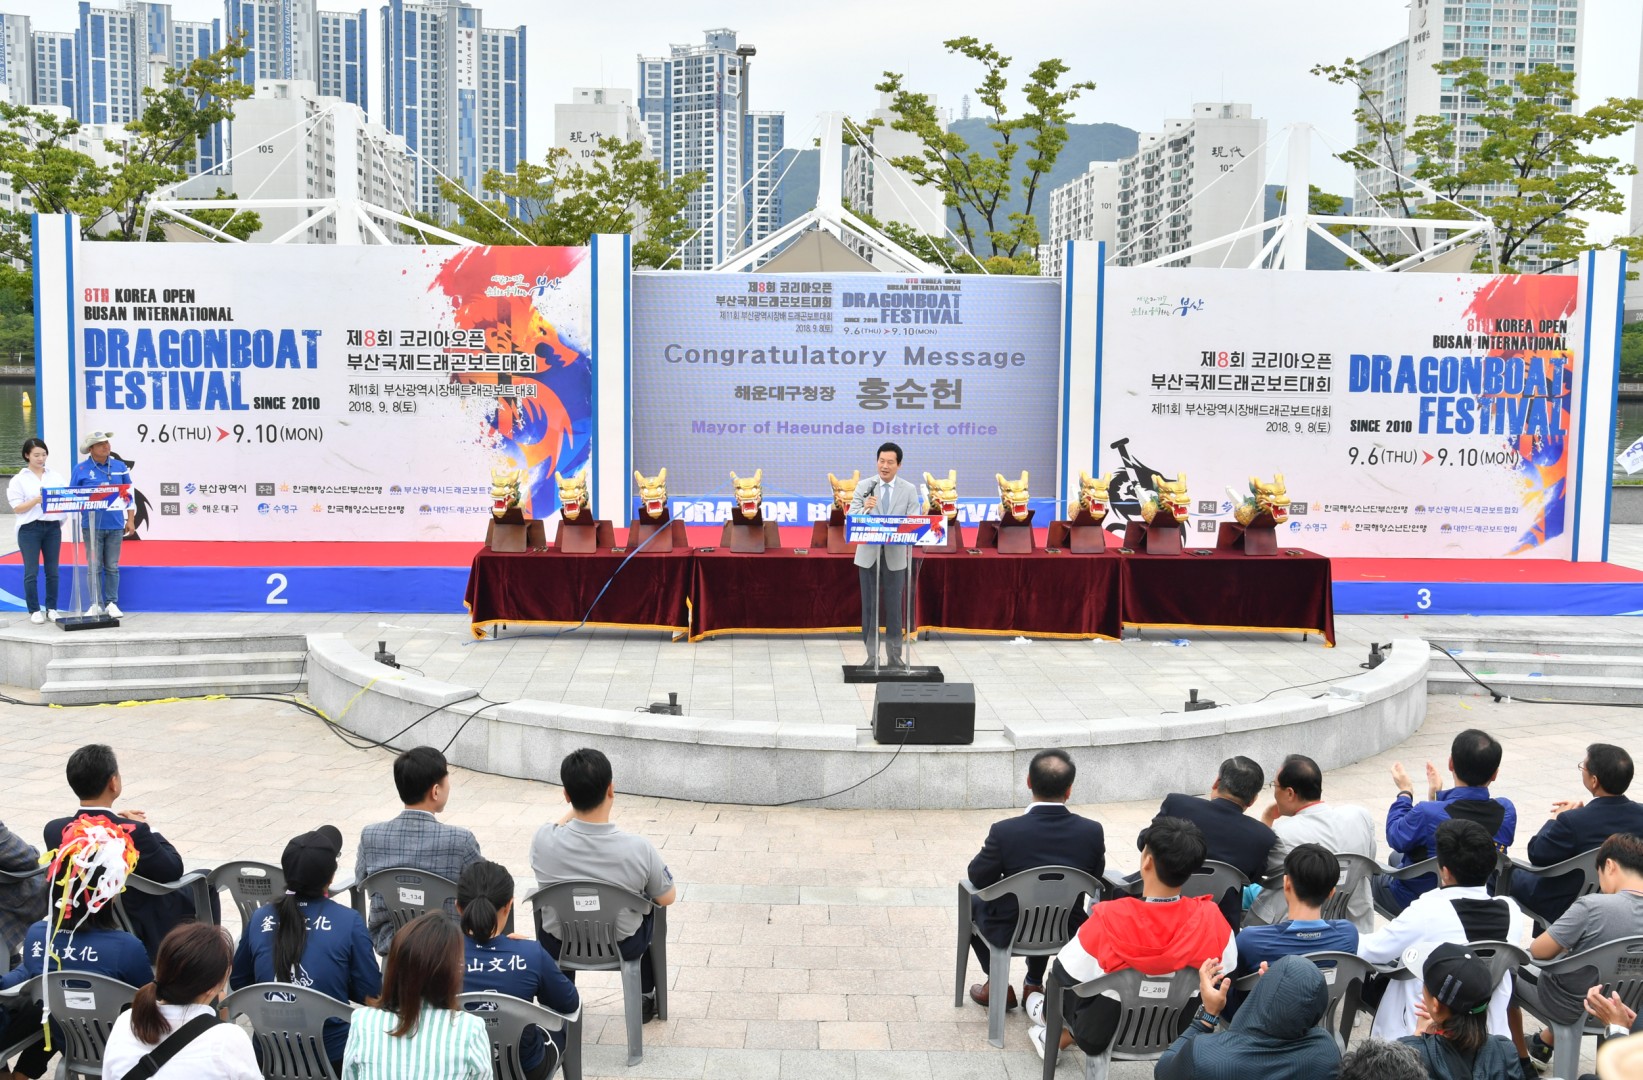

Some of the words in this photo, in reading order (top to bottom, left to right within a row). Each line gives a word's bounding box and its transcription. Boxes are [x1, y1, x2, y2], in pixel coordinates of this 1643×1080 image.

[257, 144, 274, 154] 105
[1211, 146, 1245, 158] 現代
[1101, 202, 1112, 210] 101
[748, 282, 776, 294] 제8회
[780, 282, 833, 294] 코리아오픈
[84, 288, 110, 303] 8TH
[115, 288, 157, 303] KOREA
[162, 288, 196, 304] OPEN
[715, 296, 832, 308] 부산국제드래곤보트대회
[843, 292, 963, 309] DRAGONBOAT
[1172, 296, 1205, 317] 부산
[84, 306, 128, 321] BUSAN
[133, 306, 234, 322] INTERNATIONAL
[719, 311, 740, 321] 제11회
[740, 311, 786, 322] 부산광역시장배
[787, 311, 833, 322] 드래곤보트대회
[881, 308, 964, 325] FESTIVAL
[843, 327, 882, 336] 9.6(THU)
[891, 327, 938, 337] 9.10(MON)
[1495, 319, 1533, 333] KOREA
[1539, 319, 1568, 334] OPEN
[346, 329, 393, 347] 제8회
[400, 329, 485, 349] 코리아오픈
[1433, 335, 1472, 349] BUSAN
[1477, 335, 1568, 351] INTERNATIONAL
[84, 328, 323, 370] DRAGONBOAT
[347, 353, 537, 372] 부산국제드래곤보트대회
[664, 343, 888, 368] Congratulatory
[904, 346, 1027, 370] Message
[1200, 351, 1245, 369] 제8회
[1251, 352, 1332, 370] 코리아오픈
[1348, 354, 1569, 396] DRAGONBOAT
[1151, 373, 1331, 393] 부산국제드래곤보트대회
[85, 370, 250, 411] FESTIVAL
[348, 383, 379, 397] 제11회
[384, 383, 538, 398] 부산광역시장배드래곤보트대회
[734, 385, 836, 402] 해운대구청장
[855, 377, 963, 411] 홍순헌
[253, 397, 286, 410] SINCE
[292, 397, 321, 411] 2010
[348, 401, 375, 414] 2018.
[392, 401, 417, 414] 8(토)
[1151, 402, 1181, 416] 제11회
[1185, 403, 1331, 418] 부산광역시장배드래곤보트대회
[1418, 396, 1567, 436] FESTIVAL
[691, 421, 746, 437] Mayor
[753, 421, 771, 434] of
[776, 421, 865, 435] Haeundae
[872, 422, 940, 435] District
[947, 423, 997, 436] office
[1266, 422, 1290, 434] 2018.
[1307, 422, 1331, 434] 8(토)
[1350, 419, 1381, 433] SINCE
[1386, 420, 1413, 433] 2010
[137, 423, 212, 444] 9.6(THU)
[233, 424, 324, 444] 9.10(MON)
[1348, 446, 1418, 466] 9.6(THU)
[1437, 447, 1520, 467] 9.10(MON)
[162, 484, 178, 495] 주최
[199, 483, 247, 494] 부산광역시
[258, 484, 273, 495] 주관
[292, 484, 383, 495] 한국해양소년단부산연맹
[83, 500, 109, 510] FESTIVAL
[163, 503, 179, 514] 후원
[202, 504, 239, 514] 해운대구
[273, 504, 298, 514] 수영구
[327, 504, 405, 514] 한국해양소년단연맹
[673, 501, 798, 523] DRAON
[1200, 502, 1216, 513] 주최
[1291, 504, 1306, 514] 주관
[1324, 504, 1409, 514] 한국해양소년단부산연맹
[1427, 505, 1519, 514] 부산광역시드래곤보트협회
[1200, 521, 1214, 531] 후원
[1304, 523, 1328, 532] 수영구
[1355, 523, 1427, 533] 한국해양소년단연맹
[1453, 524, 1518, 533] 대한드래곤보트협회
[890, 532, 919, 543] FESTIVAL
[266, 572, 288, 605] 2
[1416, 588, 1432, 610] 3
[260, 915, 332, 933] 釜化
[467, 954, 527, 974] 山文化
[1142, 985, 1167, 994] D_289
